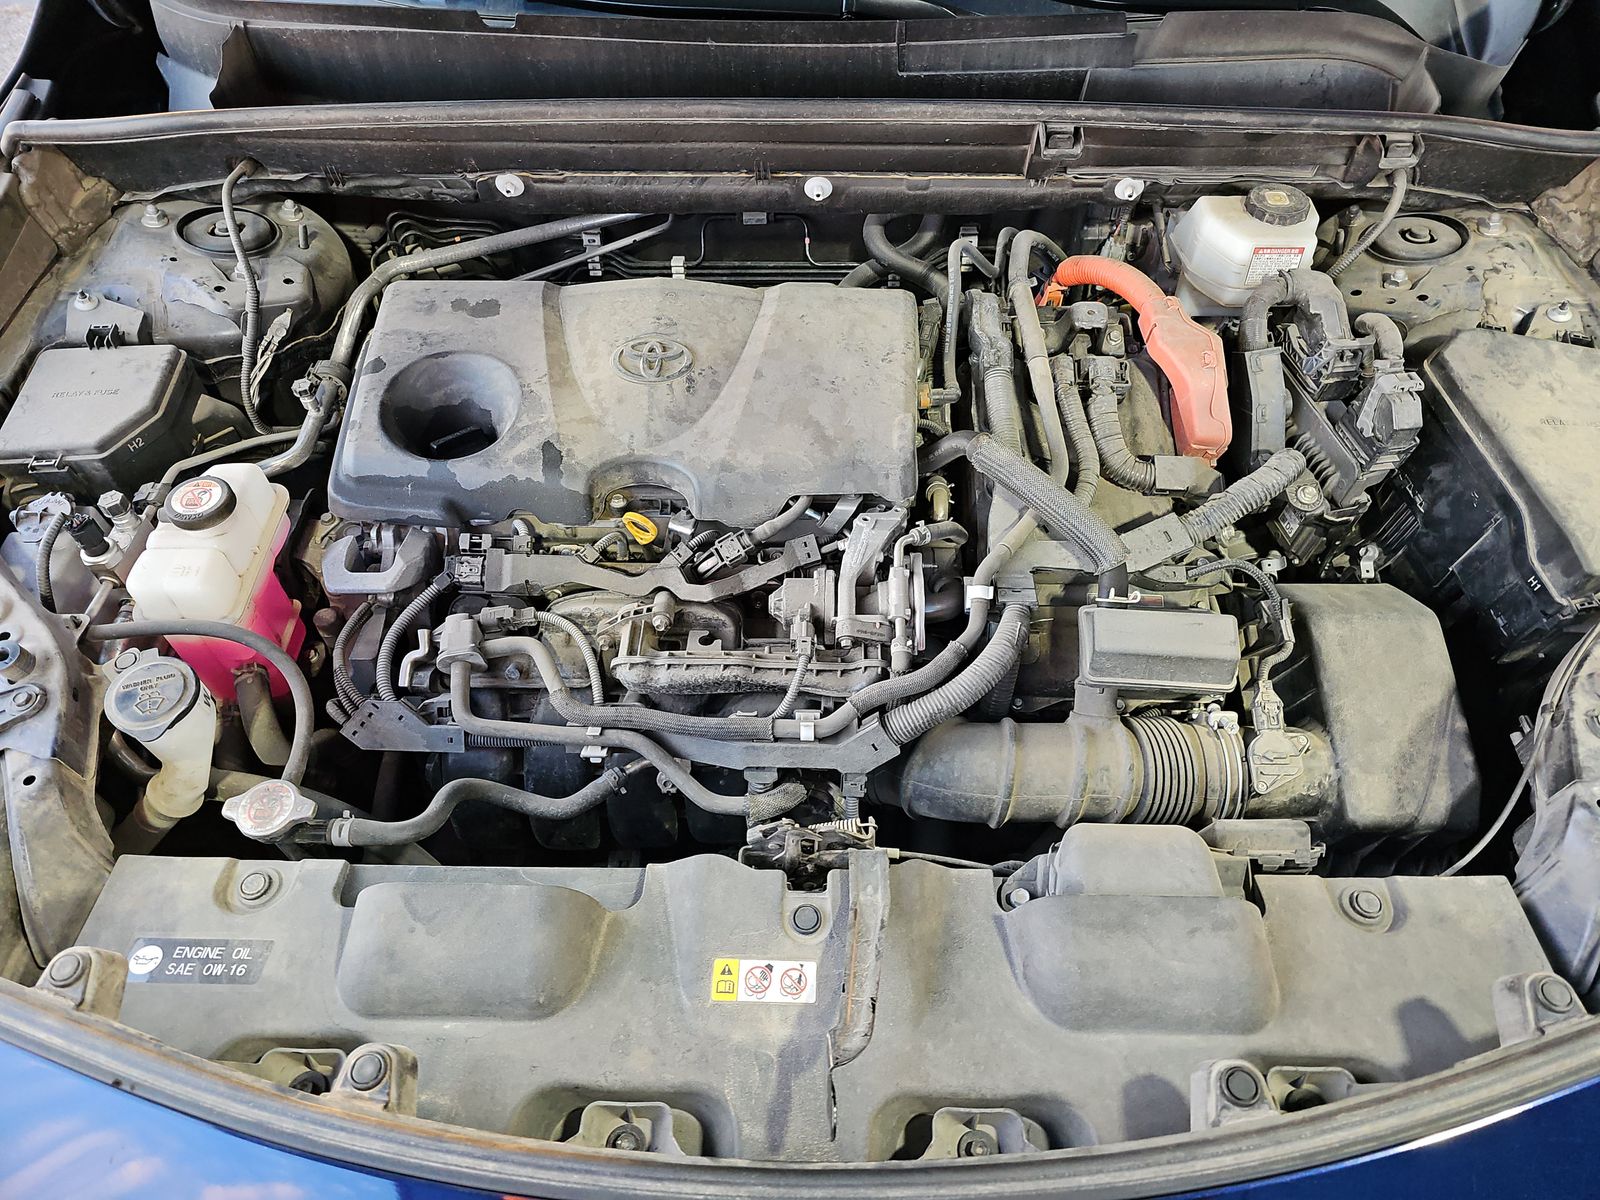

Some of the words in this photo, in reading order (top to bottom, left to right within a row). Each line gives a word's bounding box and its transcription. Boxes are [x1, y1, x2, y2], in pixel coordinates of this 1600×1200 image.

[93, 388, 120, 396] FUSE
[127, 437, 145, 452] H2
[1527, 575, 1541, 591] H1
[172, 946, 225, 959] ENGINE
[231, 947, 253, 960] OIL
[165, 962, 196, 976] SAE
[202, 963, 248, 976] 0W-16
